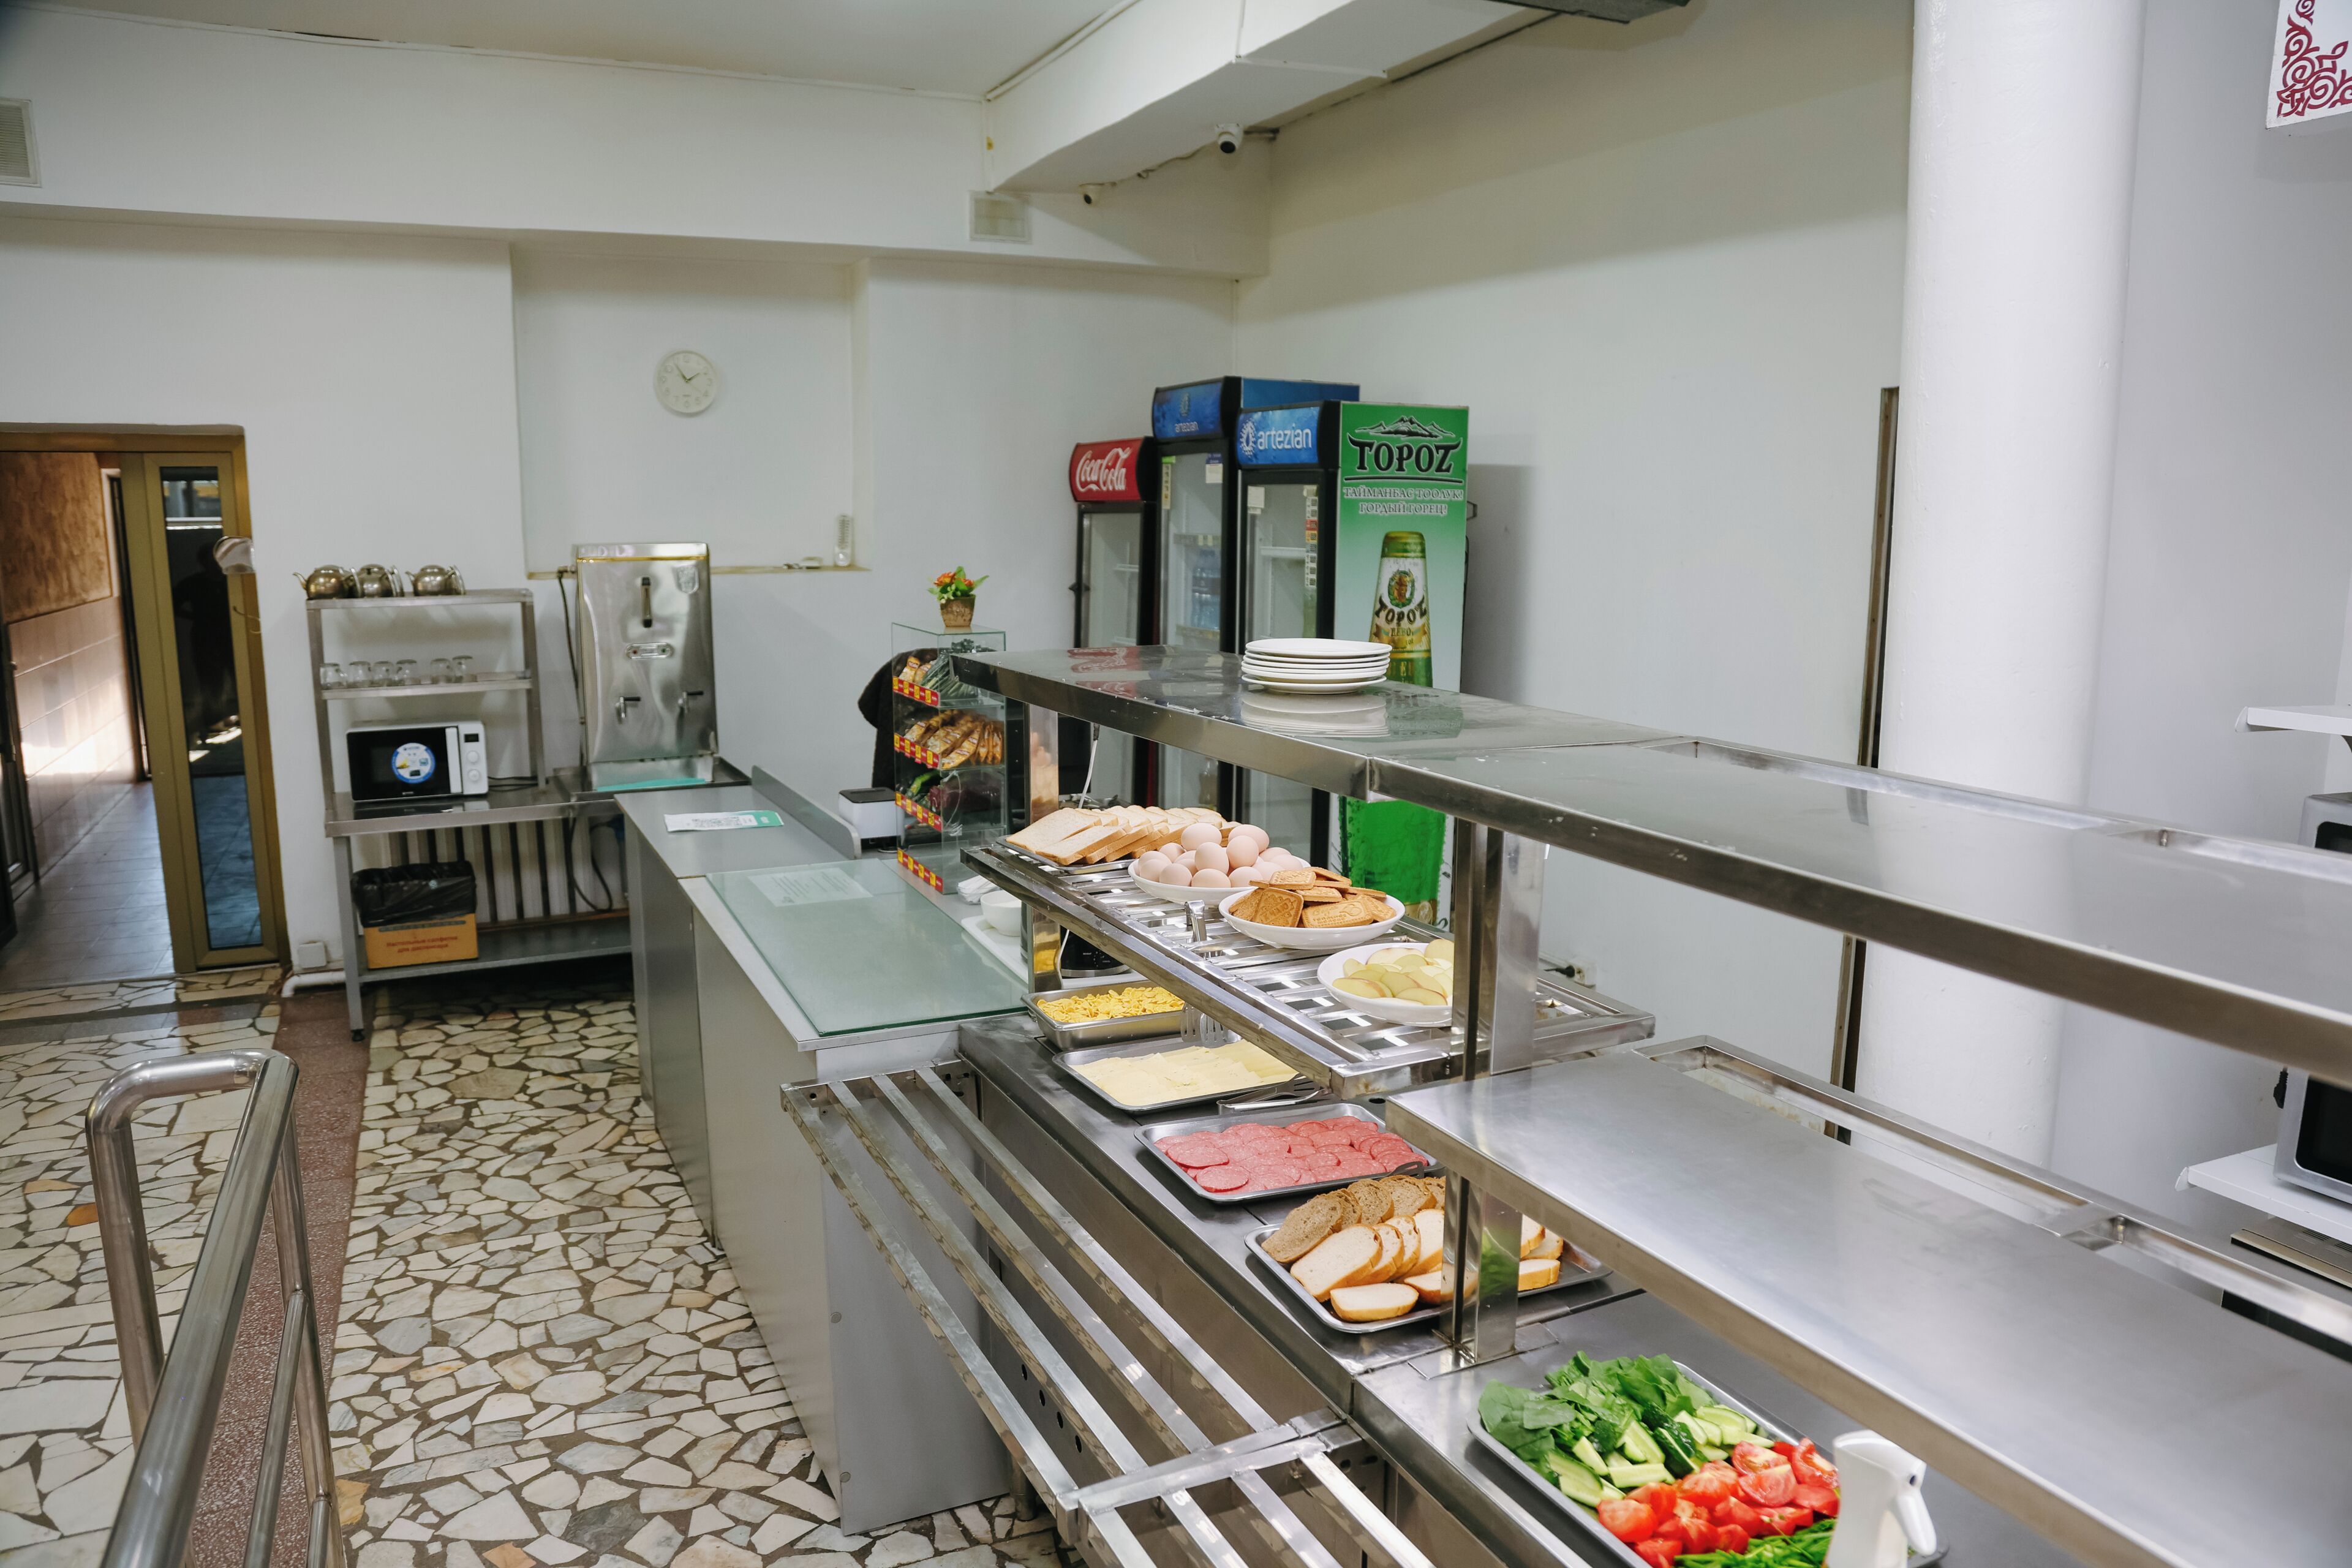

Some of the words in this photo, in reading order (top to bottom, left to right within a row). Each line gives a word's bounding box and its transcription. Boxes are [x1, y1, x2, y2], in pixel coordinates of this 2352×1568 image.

[1257, 423, 1312, 450] artezian
[1347, 432, 1463, 475] TOPOZ
[1344, 484, 1414, 499] ТАЙМАНБАС
[1360, 502, 1406, 514] ГОРДЫЙ
[1409, 503, 1447, 516] ГОРЕЦ!
